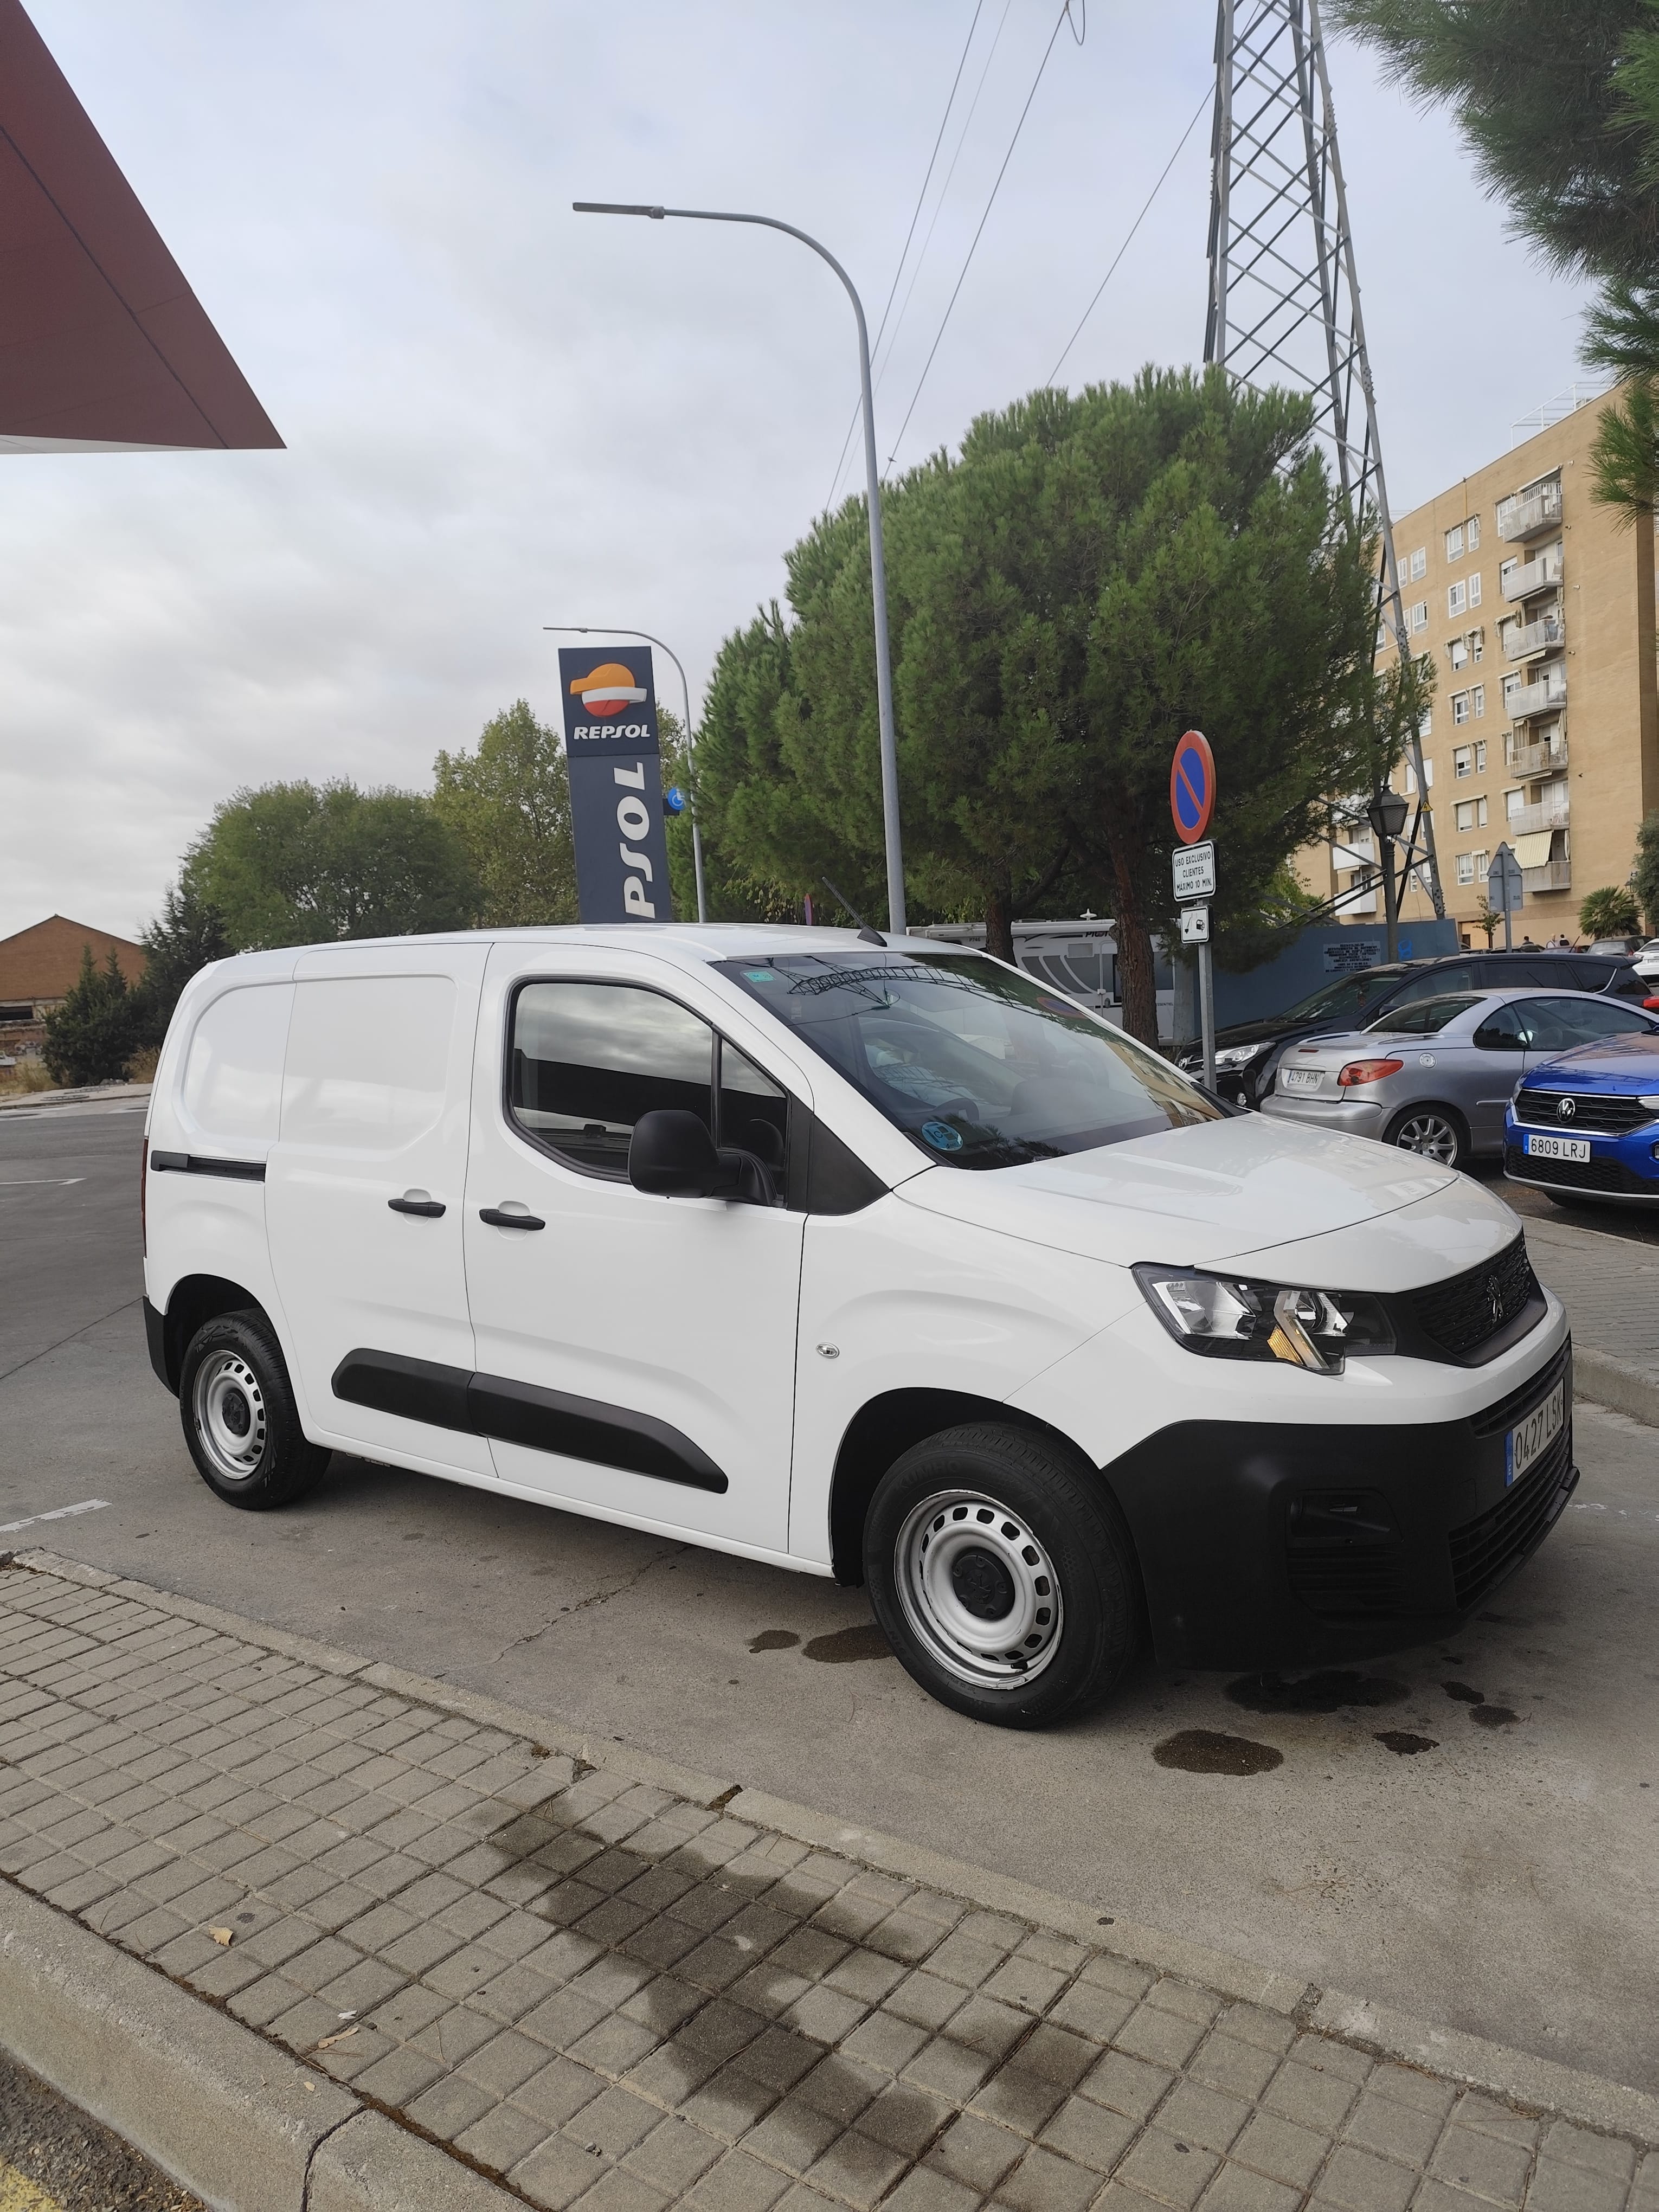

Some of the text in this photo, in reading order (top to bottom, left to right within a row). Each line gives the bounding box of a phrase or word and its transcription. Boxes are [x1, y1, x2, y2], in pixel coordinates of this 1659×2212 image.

[574, 724, 651, 740] REPSOL
[1175, 851, 1211, 867] USO EXCLUSIVO
[1182, 866, 1204, 878] CLIENTES
[1195, 879, 1200, 889] 10
[1202, 877, 1212, 888] MIN.
[1291, 1072, 1319, 1084] 4791 BHN
[1531, 1139, 1586, 1159] 6809 LRJ
[1515, 1387, 1562, 1469] 0427 LSK
[1508, 1464, 1512, 1476] E
